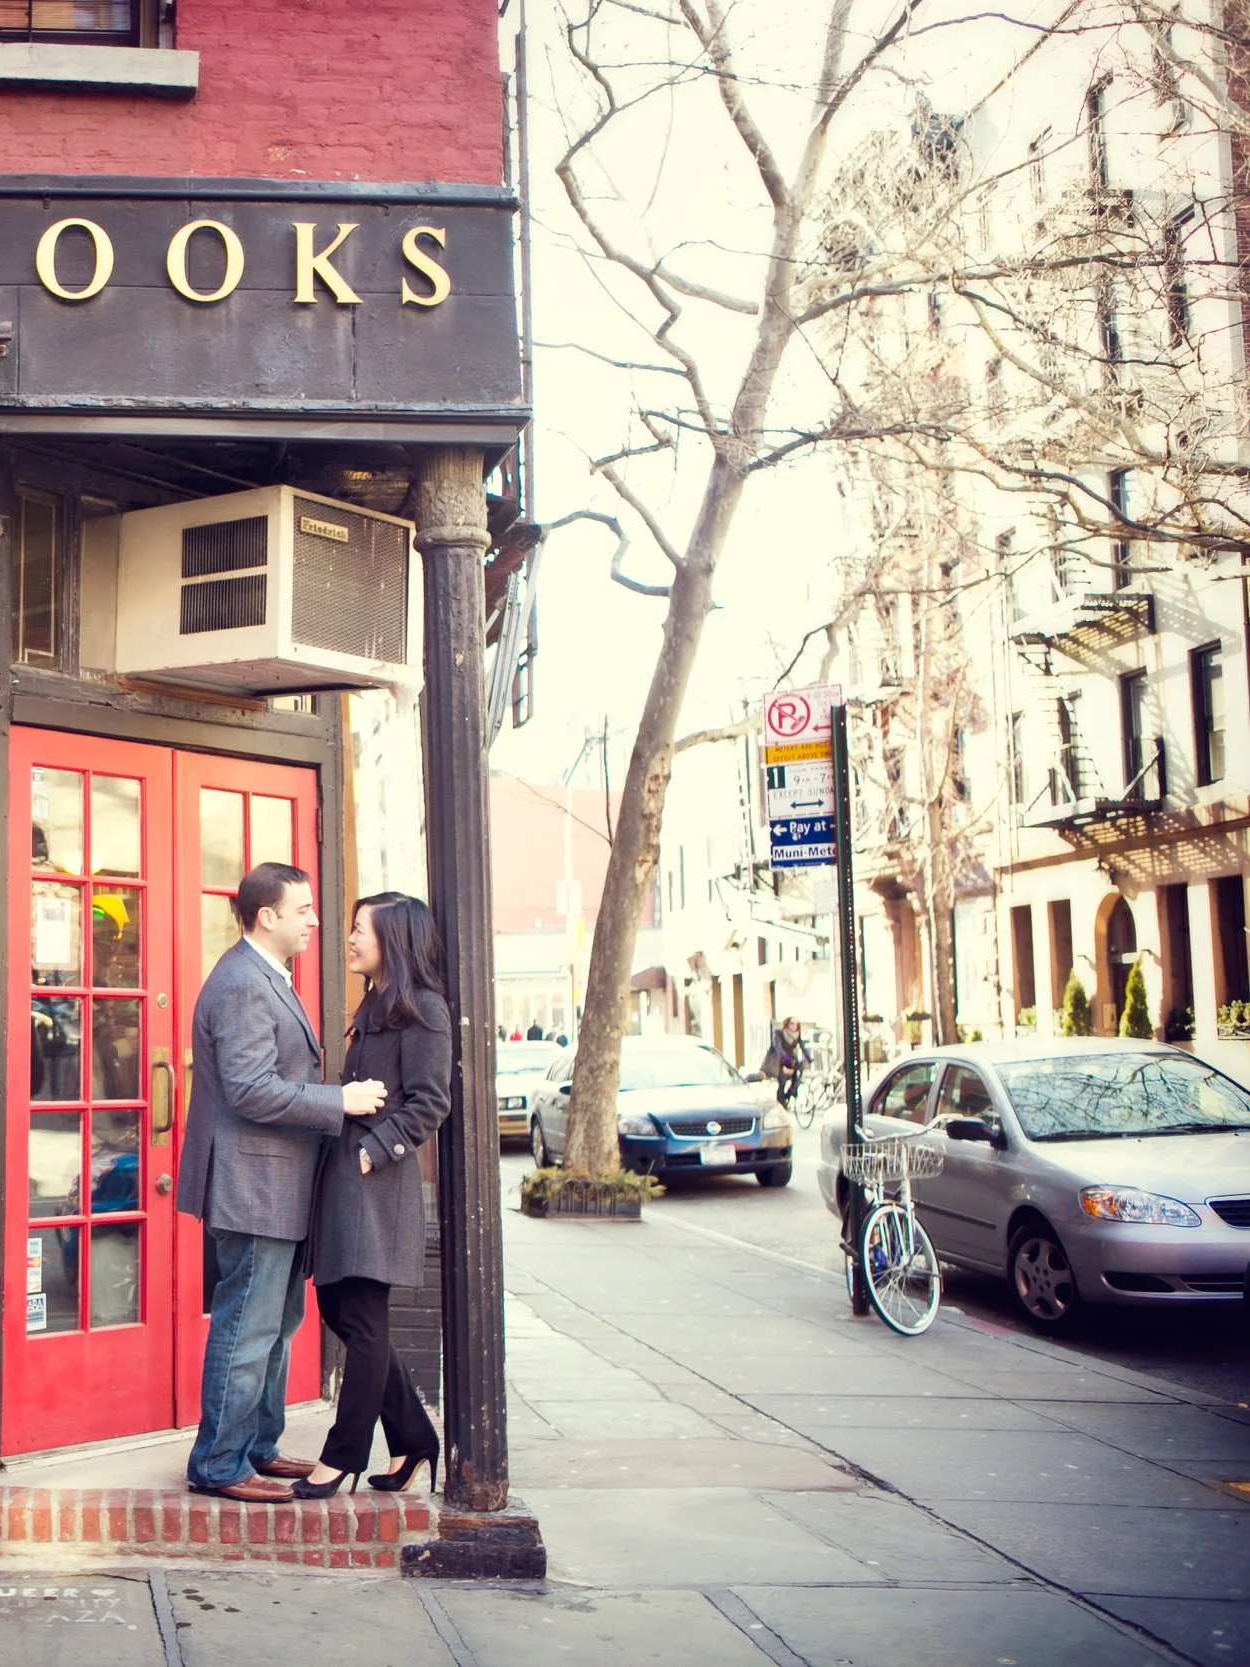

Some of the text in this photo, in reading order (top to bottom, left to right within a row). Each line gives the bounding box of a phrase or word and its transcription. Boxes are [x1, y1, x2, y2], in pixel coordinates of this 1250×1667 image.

[775, 744, 798, 752] METERS
[798, 752, 817, 760] ABOVE
[773, 768, 778, 788] 1
[774, 786, 834, 800] EXCEPT SUNDA
[790, 820, 828, 836] Pay at
[774, 846, 837, 859] Muni-Mete
[23, 1609, 127, 1624] AZA
